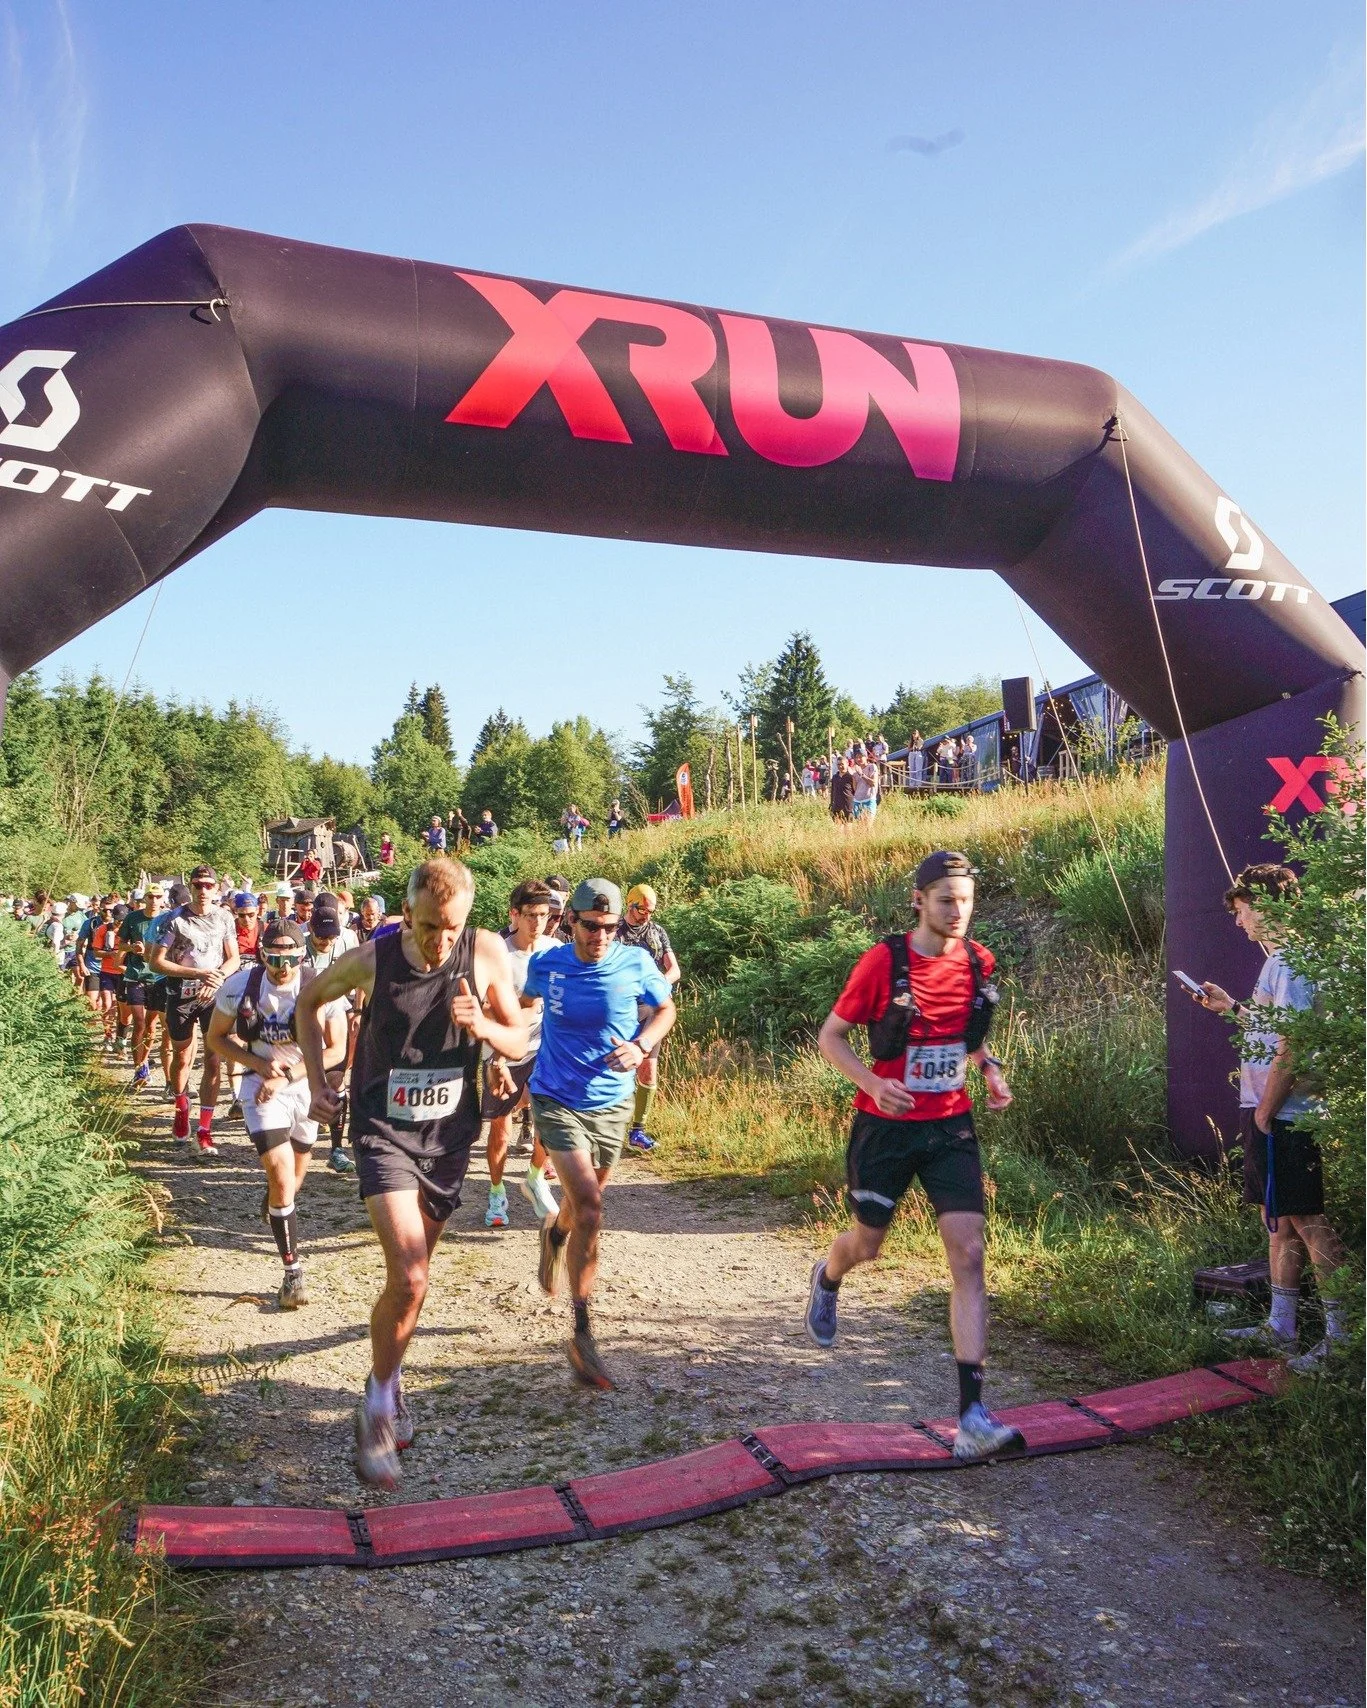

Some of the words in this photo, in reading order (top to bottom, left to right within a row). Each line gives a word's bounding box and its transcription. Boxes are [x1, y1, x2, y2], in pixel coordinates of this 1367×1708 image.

[445, 272, 961, 482] XRUN
[0, 457, 152, 512] OTT
[1151, 578, 1313, 604] SCOTT
[393, 1086, 449, 1107] 4086
